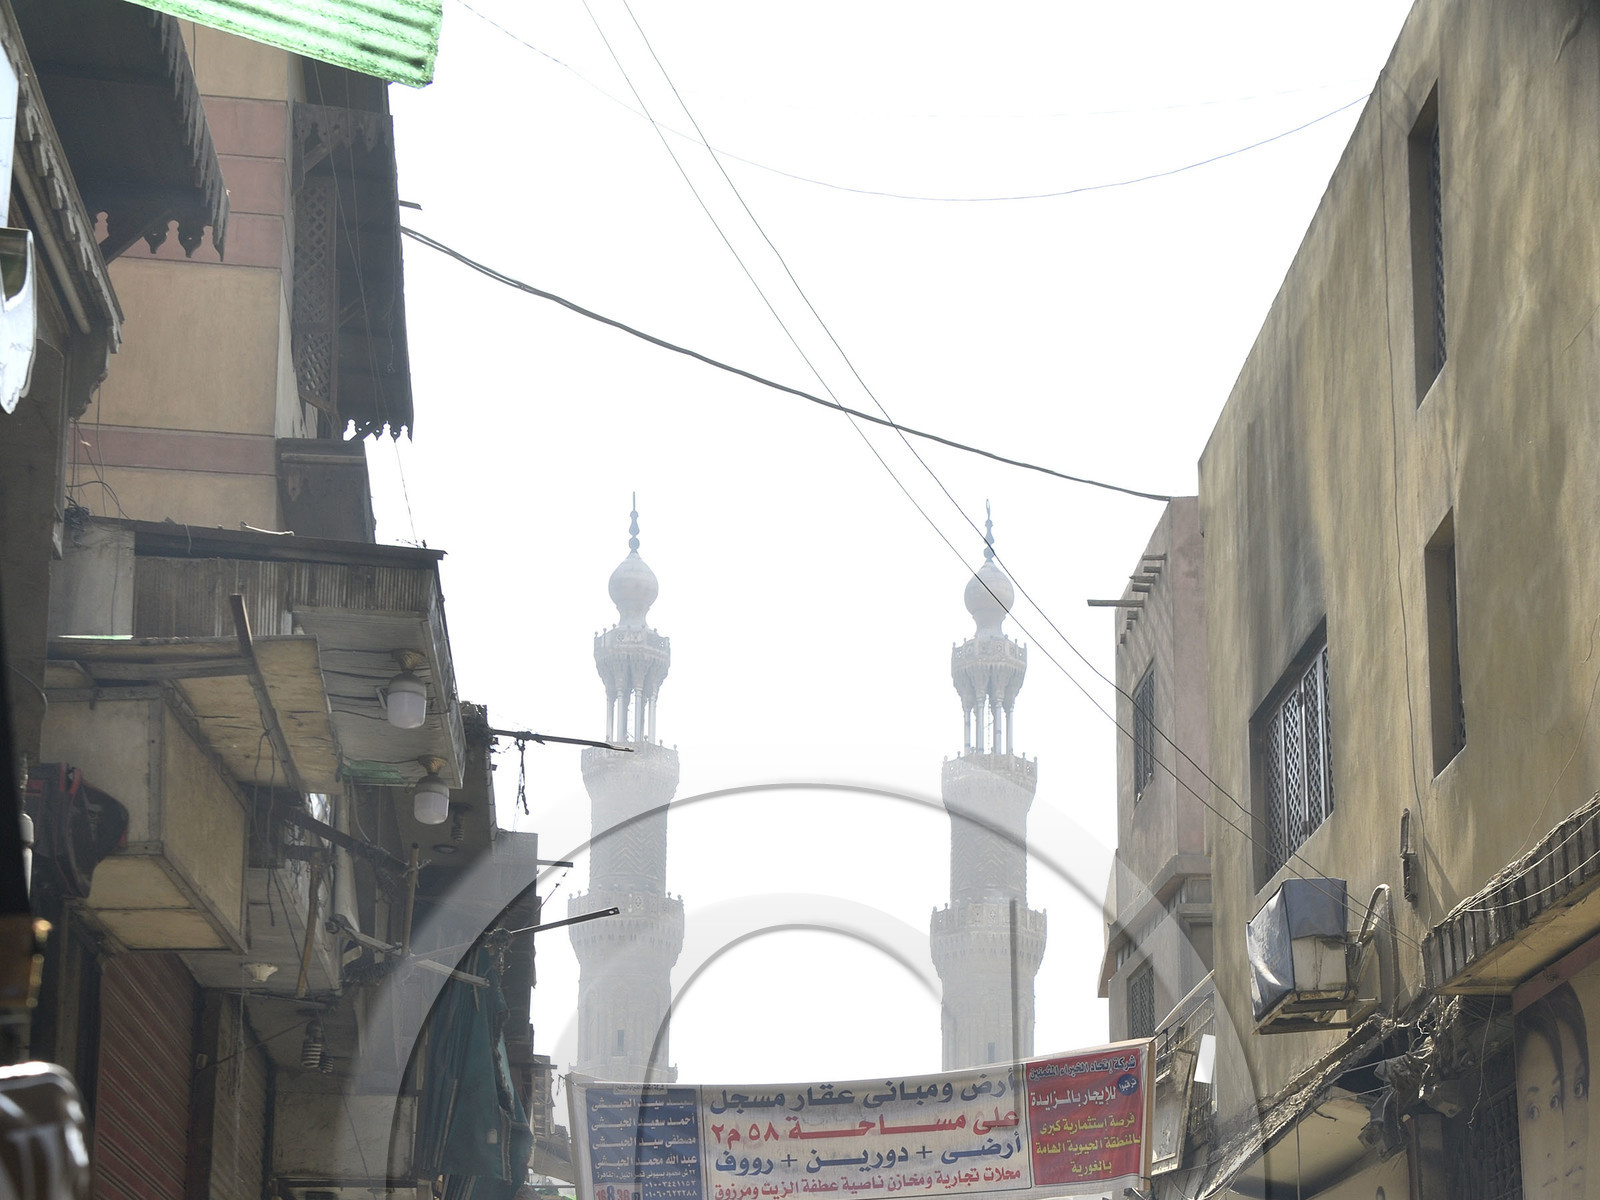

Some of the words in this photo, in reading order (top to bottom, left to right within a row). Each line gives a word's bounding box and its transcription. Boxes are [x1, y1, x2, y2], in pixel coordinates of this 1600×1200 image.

[1113, 1055, 1136, 1071] شركة
[961, 1067, 1014, 1101] أرض
[710, 1090, 785, 1114] مسجل
[789, 1084, 855, 1112] عقار
[638, 1117, 665, 1129] سعيد
[666, 1112, 695, 1126] أحمد
[973, 1106, 1019, 1135] على
[1109, 1112, 1135, 1127] فرصة
[749, 1122, 780, 1141] ٥٨
[1066, 1140, 1103, 1155] الحيوية
[636, 1157, 663, 1166] محمد
[665, 1153, 679, 1165] الله
[681, 1155, 697, 1167] عبد
[715, 1151, 774, 1176] رووف
[806, 1147, 909, 1173] دورين
[887, 1173, 933, 1191] ومخازن
[934, 1168, 979, 1189] تجارية
[983, 1167, 1021, 1182] محلات
[761, 1181, 799, 1200] الزيت
[801, 1178, 839, 1193] عطفة
[841, 1175, 884, 1194] ناصية
